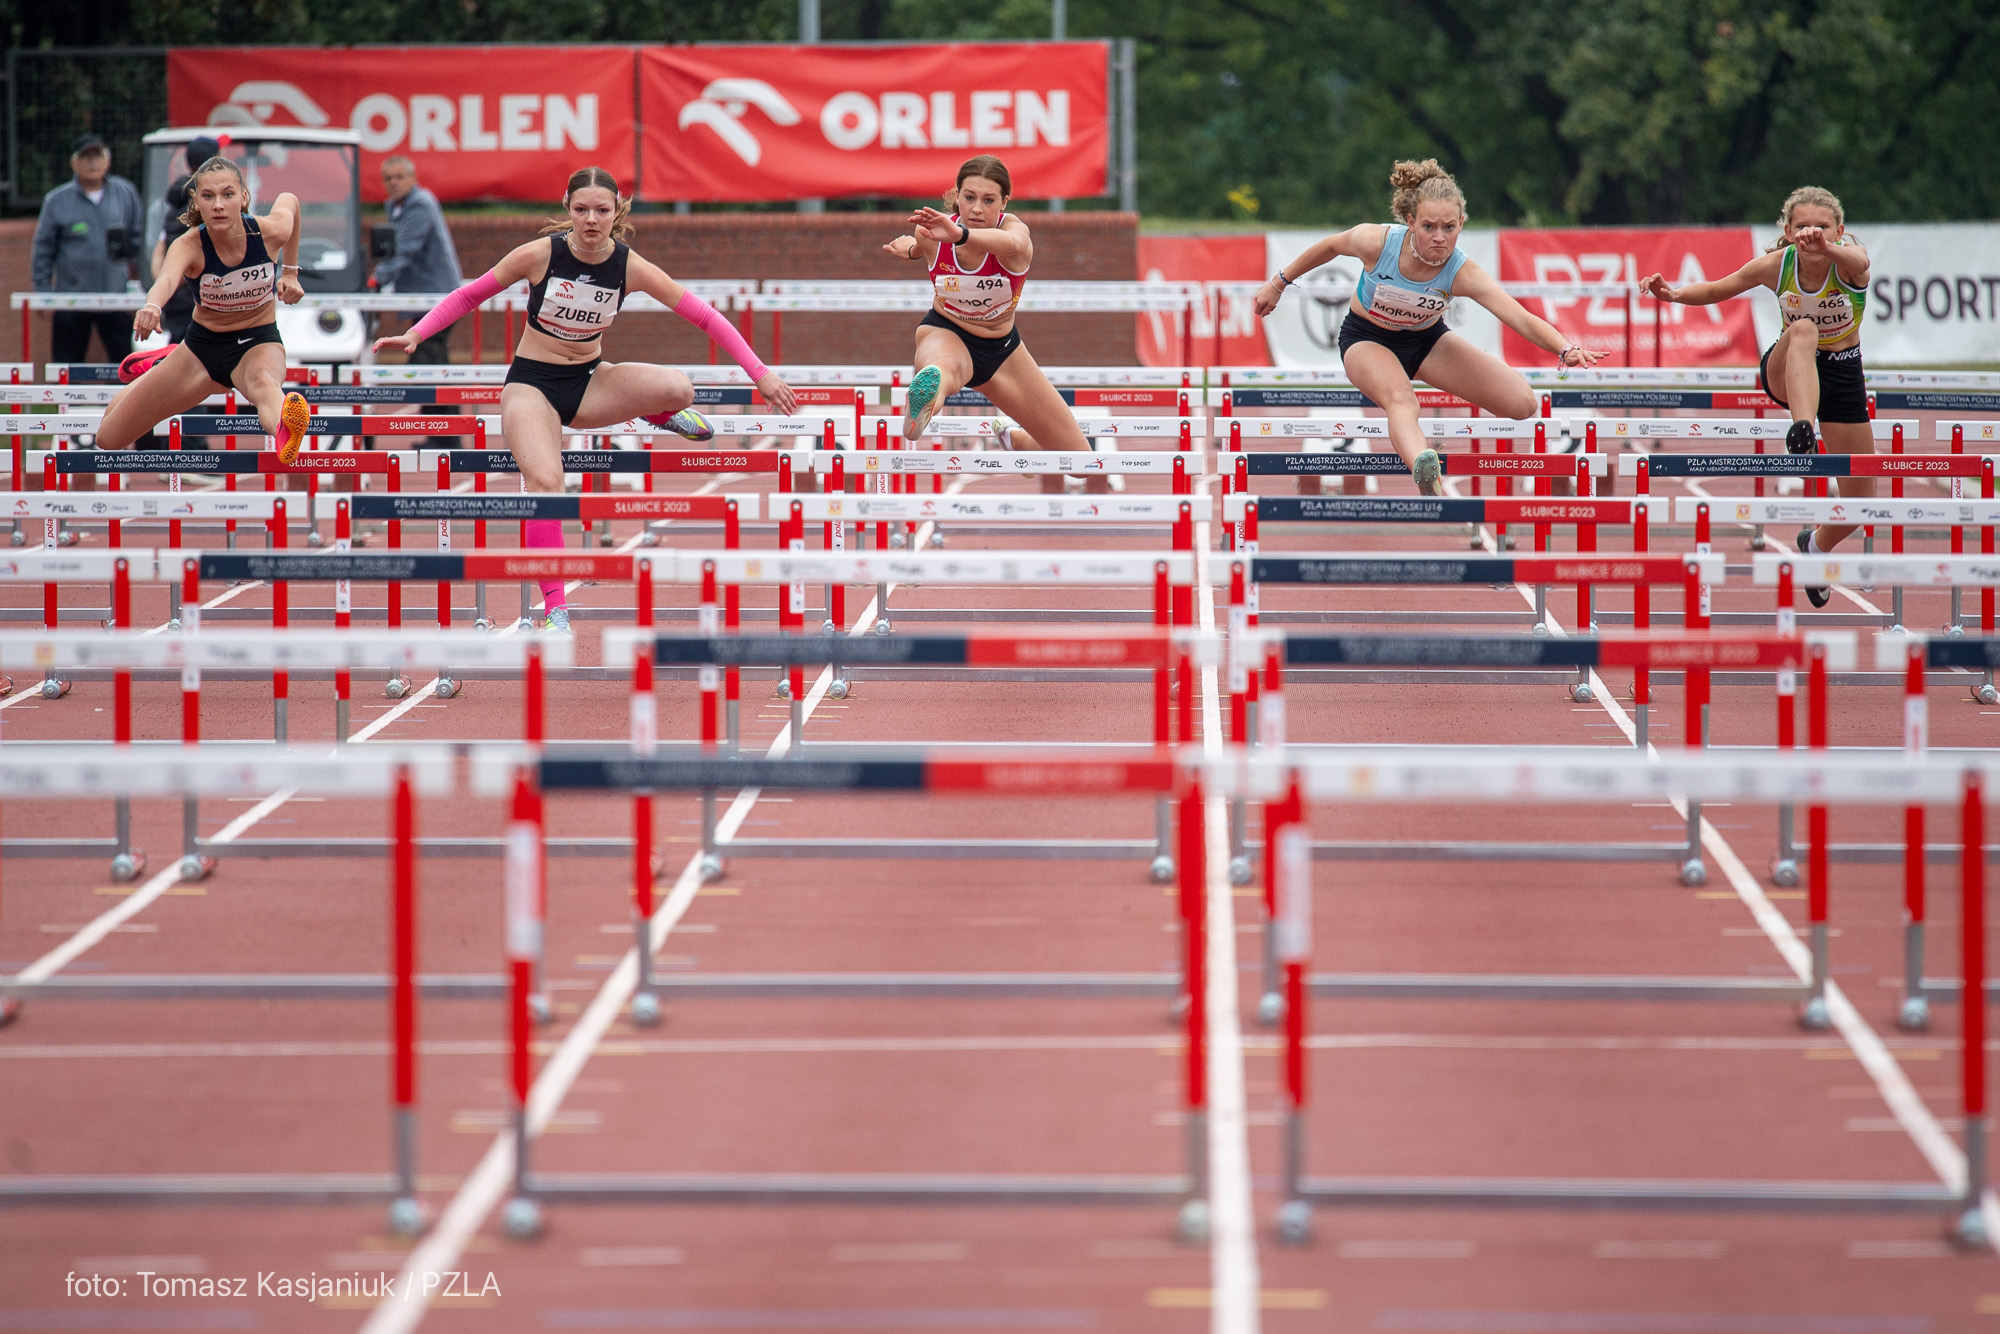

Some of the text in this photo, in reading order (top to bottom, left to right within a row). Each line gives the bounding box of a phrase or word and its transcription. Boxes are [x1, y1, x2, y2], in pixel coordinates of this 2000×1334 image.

[349, 93, 598, 152] ORLEN
[819, 91, 1071, 150] ORLEN
[939, 262, 956, 274] esa
[242, 267, 268, 282] 991
[976, 279, 1004, 290] 494
[1533, 252, 1724, 327] PZLA
[202, 282, 272, 301] KOMMISARCZYK
[594, 290, 614, 304] 87
[1417, 296, 1444, 312] 232
[1818, 296, 1845, 310] 465
[1874, 276, 2000, 322] SPORT
[554, 306, 602, 324] ZUBEL
[1828, 347, 1860, 360] NIKE
[461, 391, 493, 399] SŁUBICE
[289, 458, 356, 467] SŁUBICE 2023
[682, 457, 747, 466] SŁUBICE 2023
[1478, 460, 1544, 468] SŁUBICE 2023
[1882, 461, 1949, 470] SŁUBICE 2023
[52, 504, 76, 513] FUEL
[394, 500, 537, 509] PZLA MISTRZOSTWA POLSKI U16
[615, 502, 690, 512] SŁUBICE 2023
[960, 505, 983, 514] FUEL
[1391, 502, 1422, 511] POLSKI
[1521, 506, 1595, 517] SŁUBICE 2023
[1868, 509, 1893, 518] FUEL
